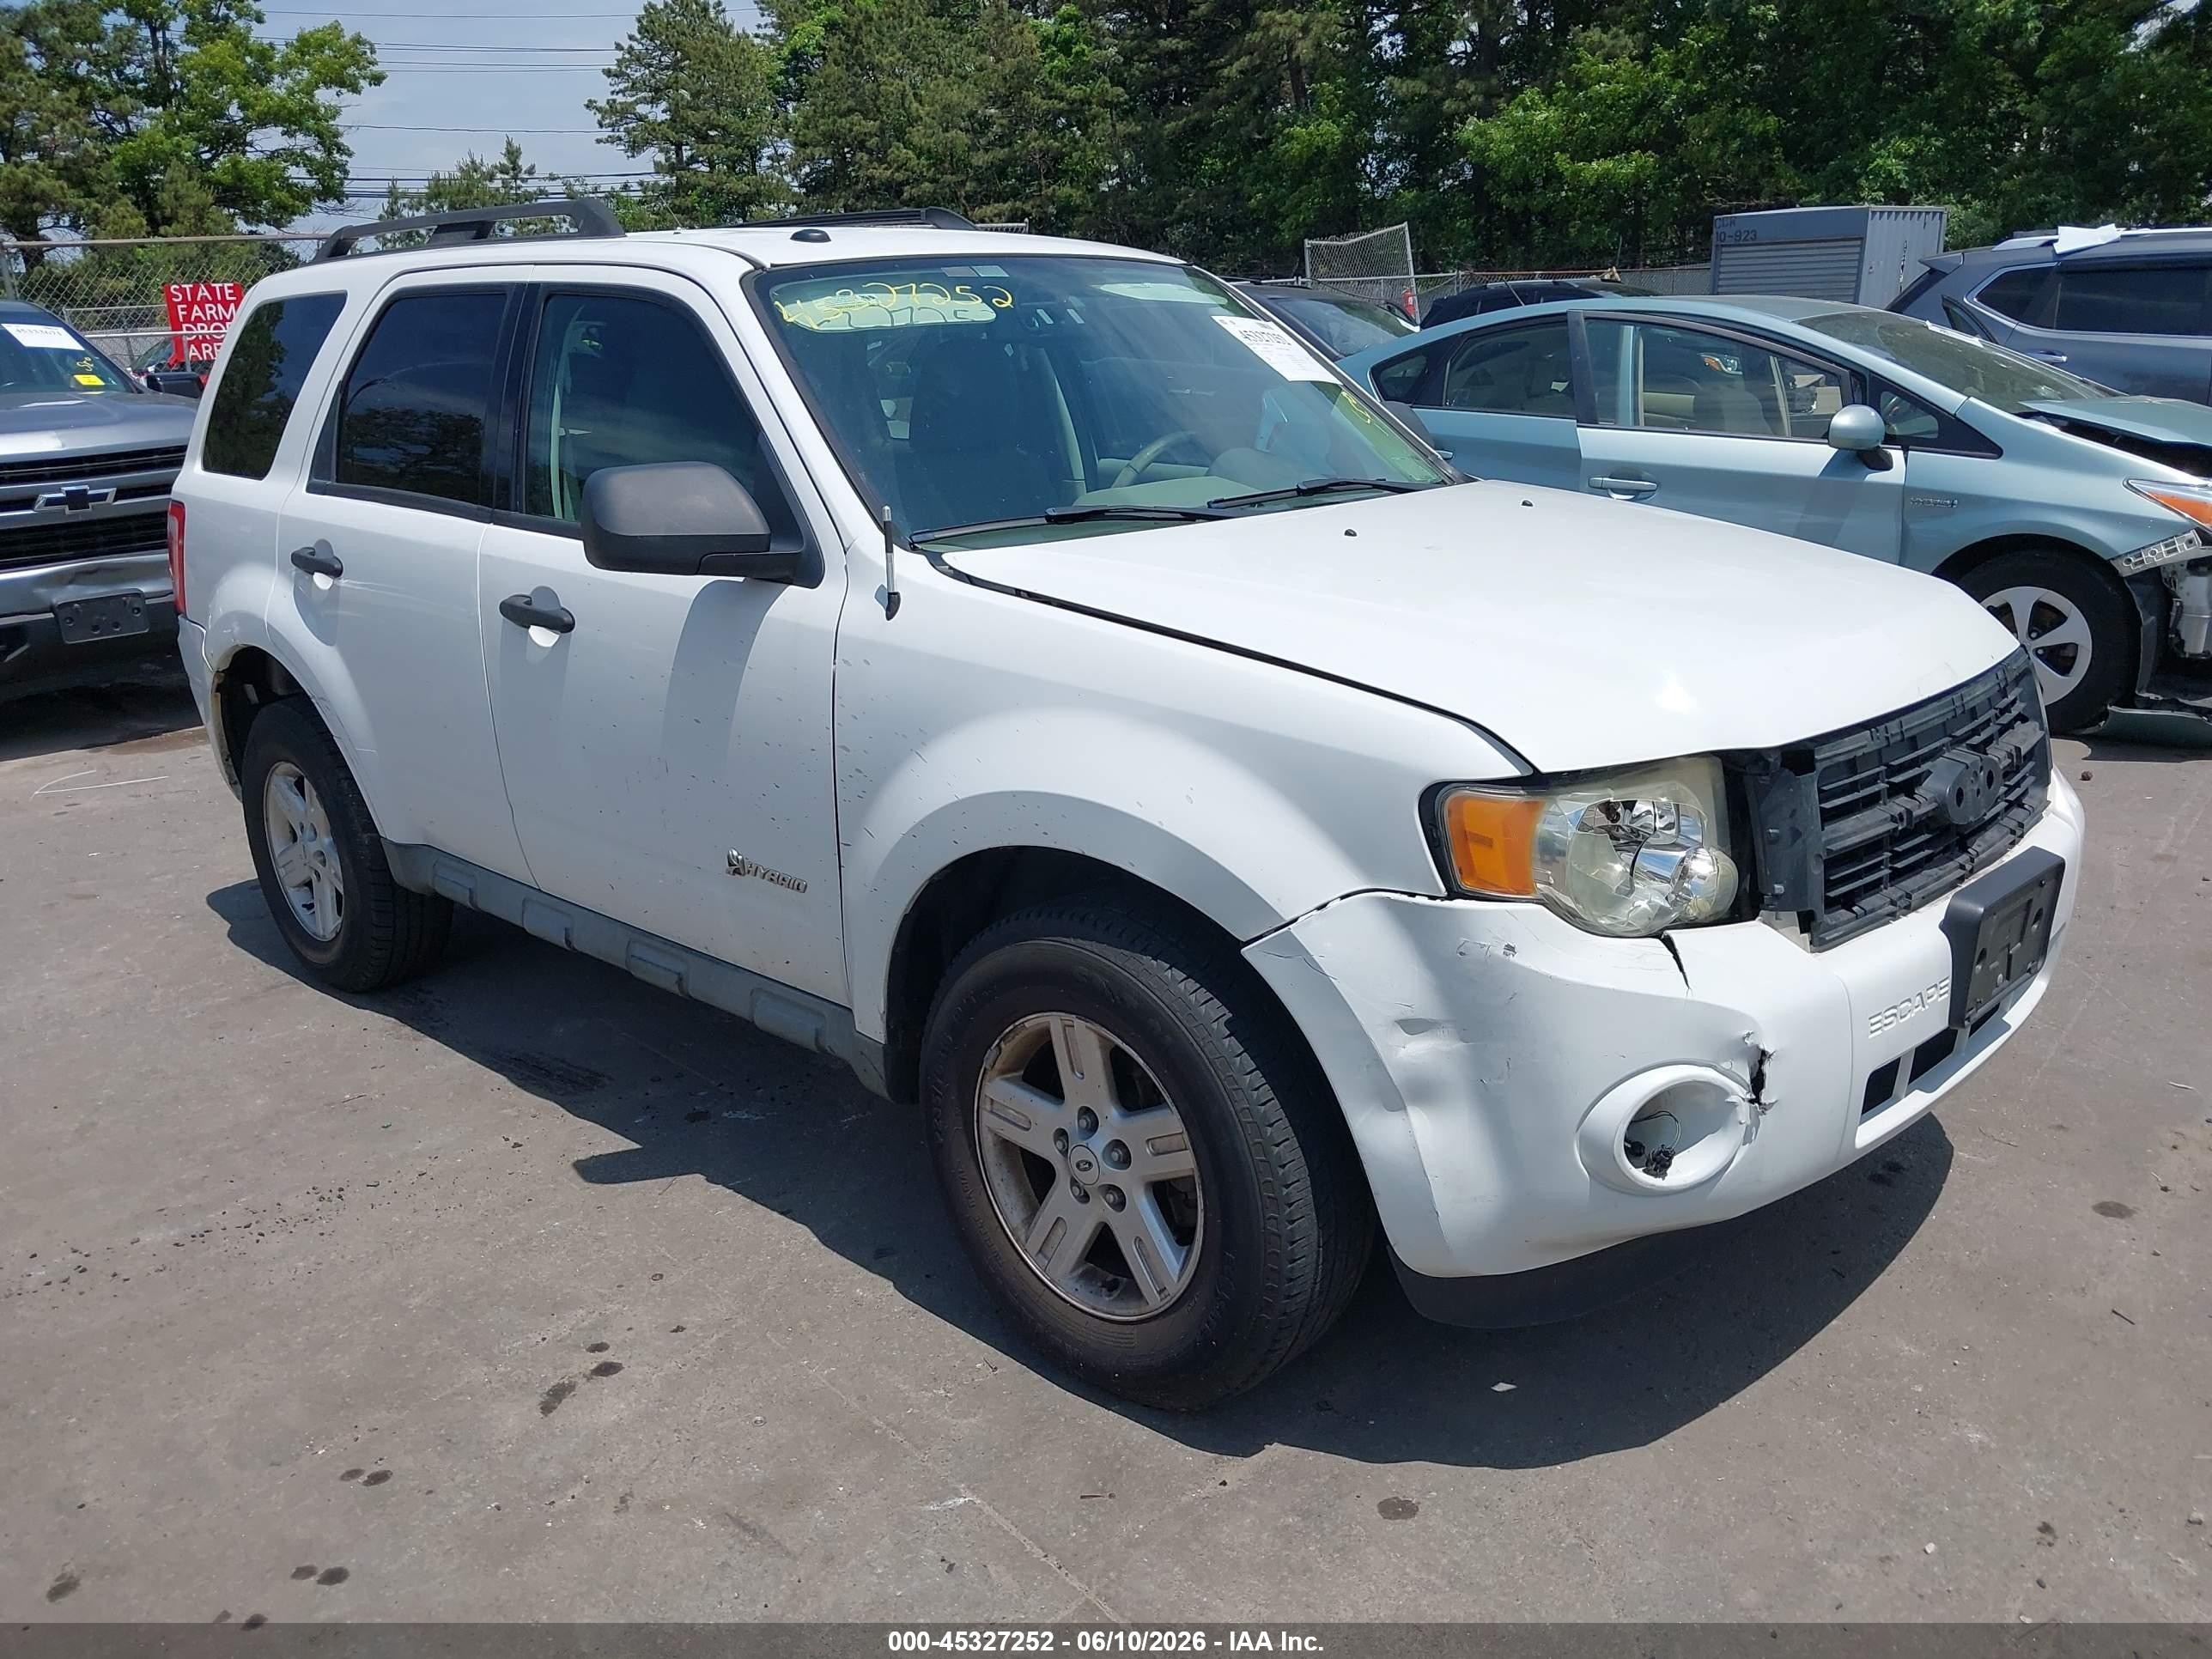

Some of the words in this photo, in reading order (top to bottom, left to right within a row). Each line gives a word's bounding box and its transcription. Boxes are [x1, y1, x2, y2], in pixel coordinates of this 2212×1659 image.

[170, 283, 237, 301] STATE
[177, 303, 235, 322] FARM
[745, 861, 807, 893] HYBRID
[1869, 976, 1950, 1039] ESCAPE
